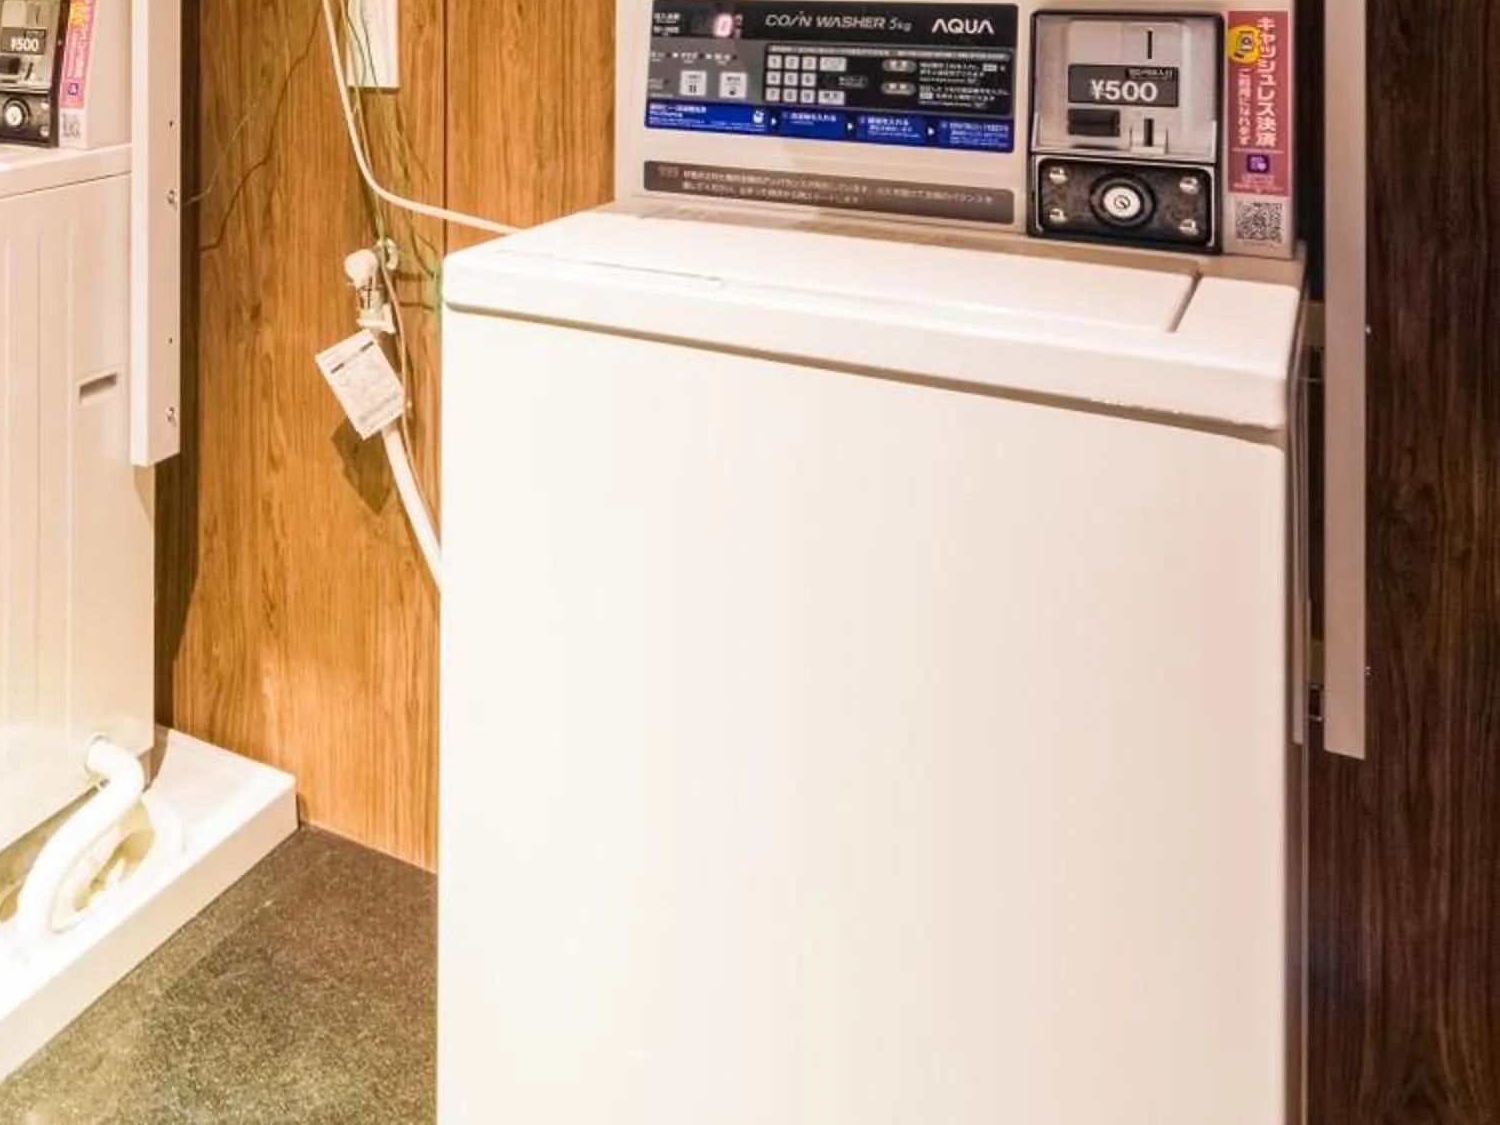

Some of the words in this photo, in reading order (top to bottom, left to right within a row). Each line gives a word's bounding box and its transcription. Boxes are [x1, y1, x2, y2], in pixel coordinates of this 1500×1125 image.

[765, 11, 813, 27] COIN
[815, 15, 886, 30] WASHER
[888, 18, 913, 32] 5kg
[931, 18, 995, 35] AQUA
[11, 37, 39, 52] ¥500
[1091, 79, 1158, 103] ¥500
[1256, 16, 1277, 147] キャッシュレス決済
